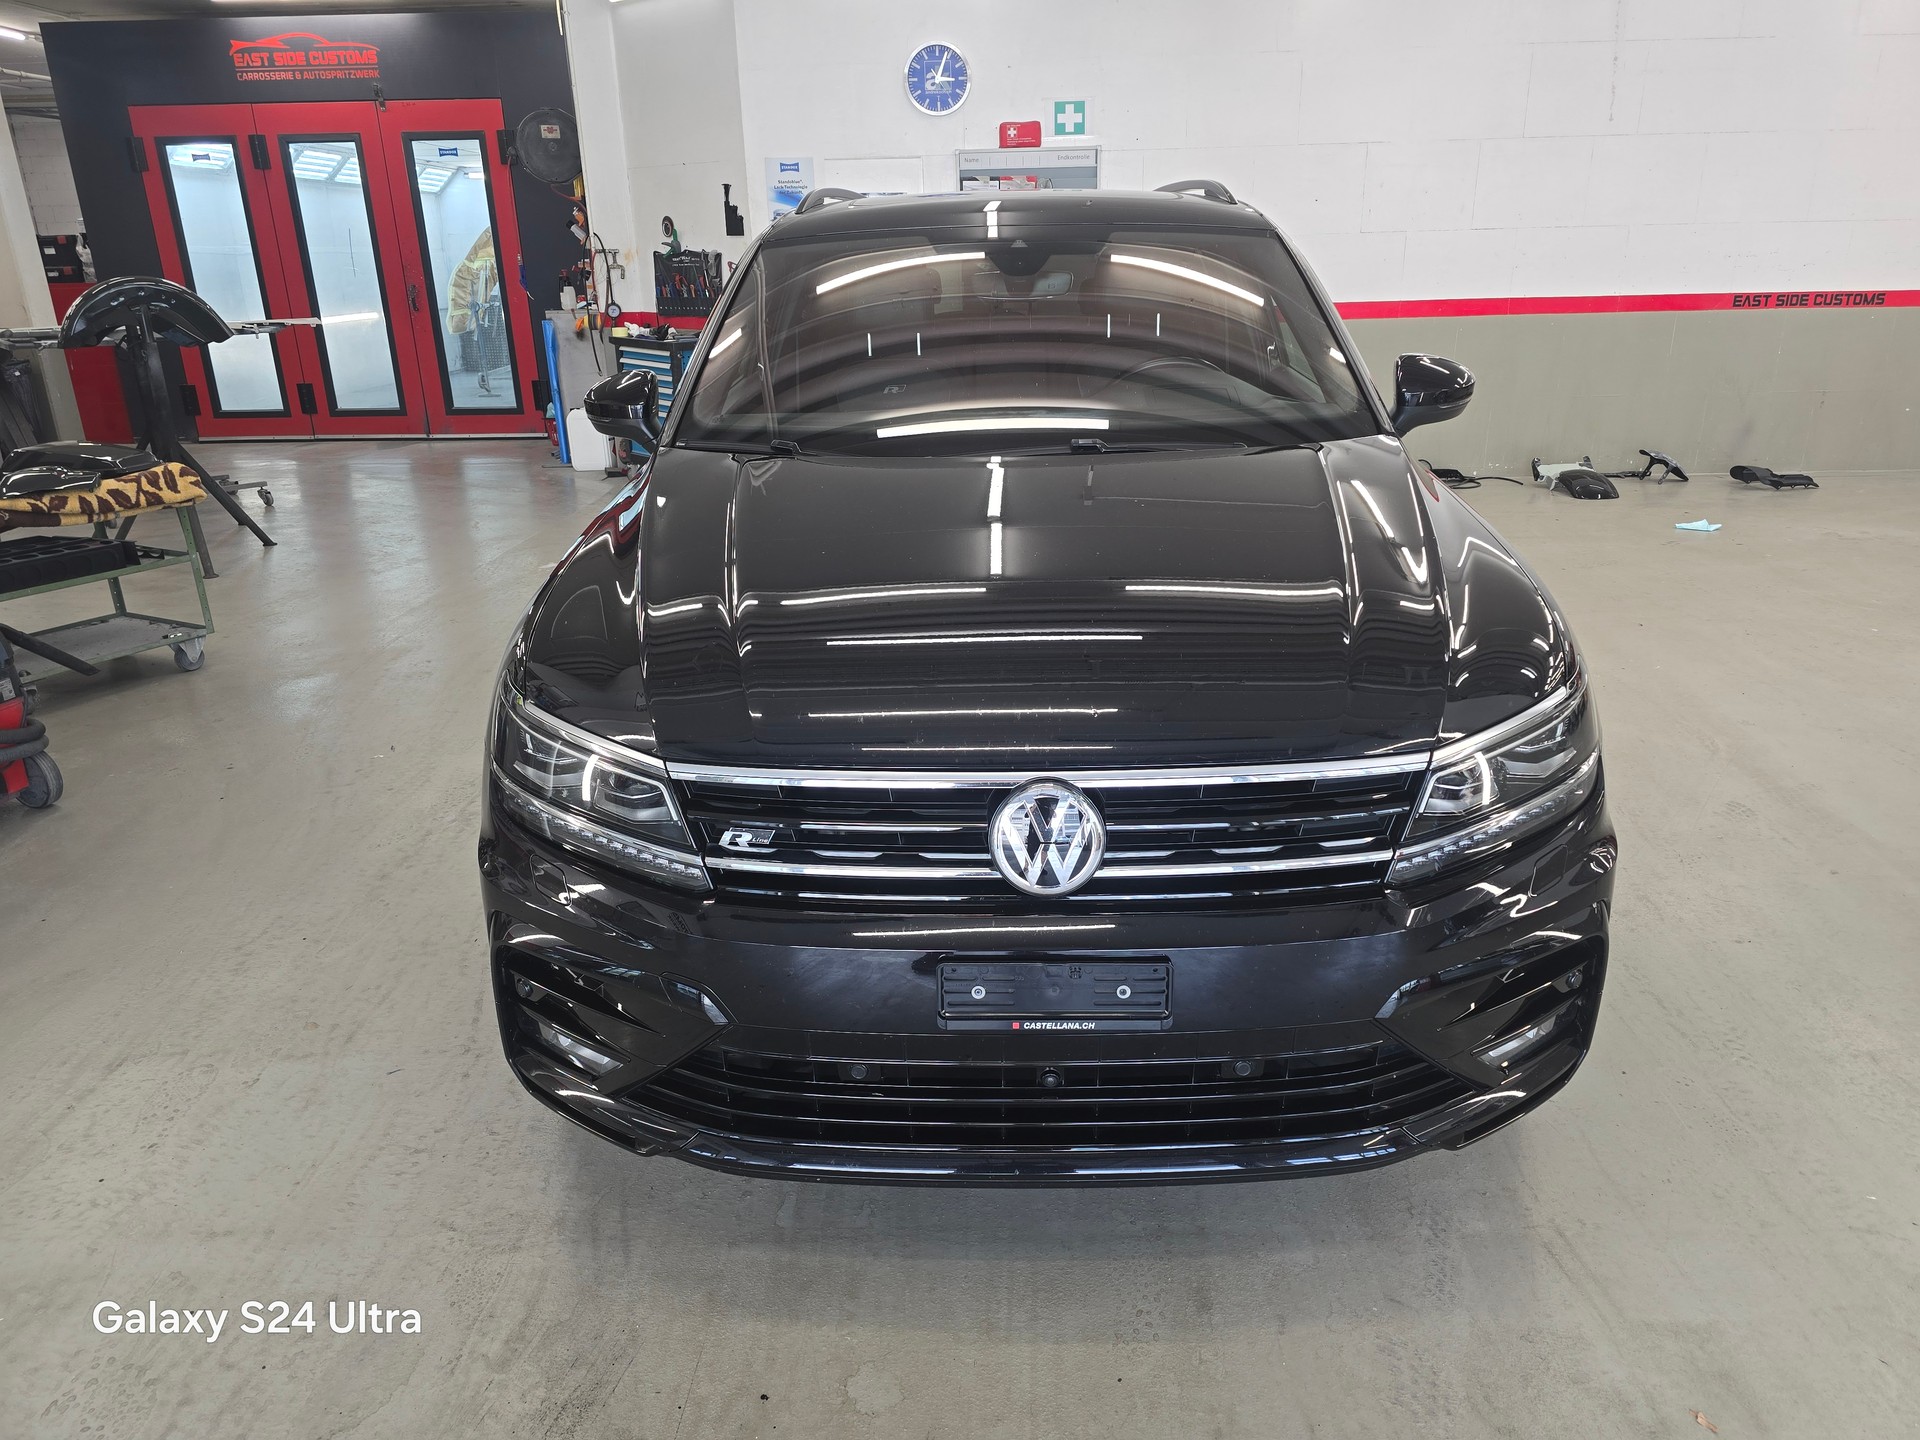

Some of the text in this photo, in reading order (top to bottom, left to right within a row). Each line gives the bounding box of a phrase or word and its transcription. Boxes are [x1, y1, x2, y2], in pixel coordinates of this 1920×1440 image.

[233, 50, 378, 67] EAST SIDE CUSTOMS
[236, 69, 380, 81] CARROSSERIE & AUTOSPRITZWERK
[1732, 293, 1886, 307] EAST SIDE CUSTOMS
